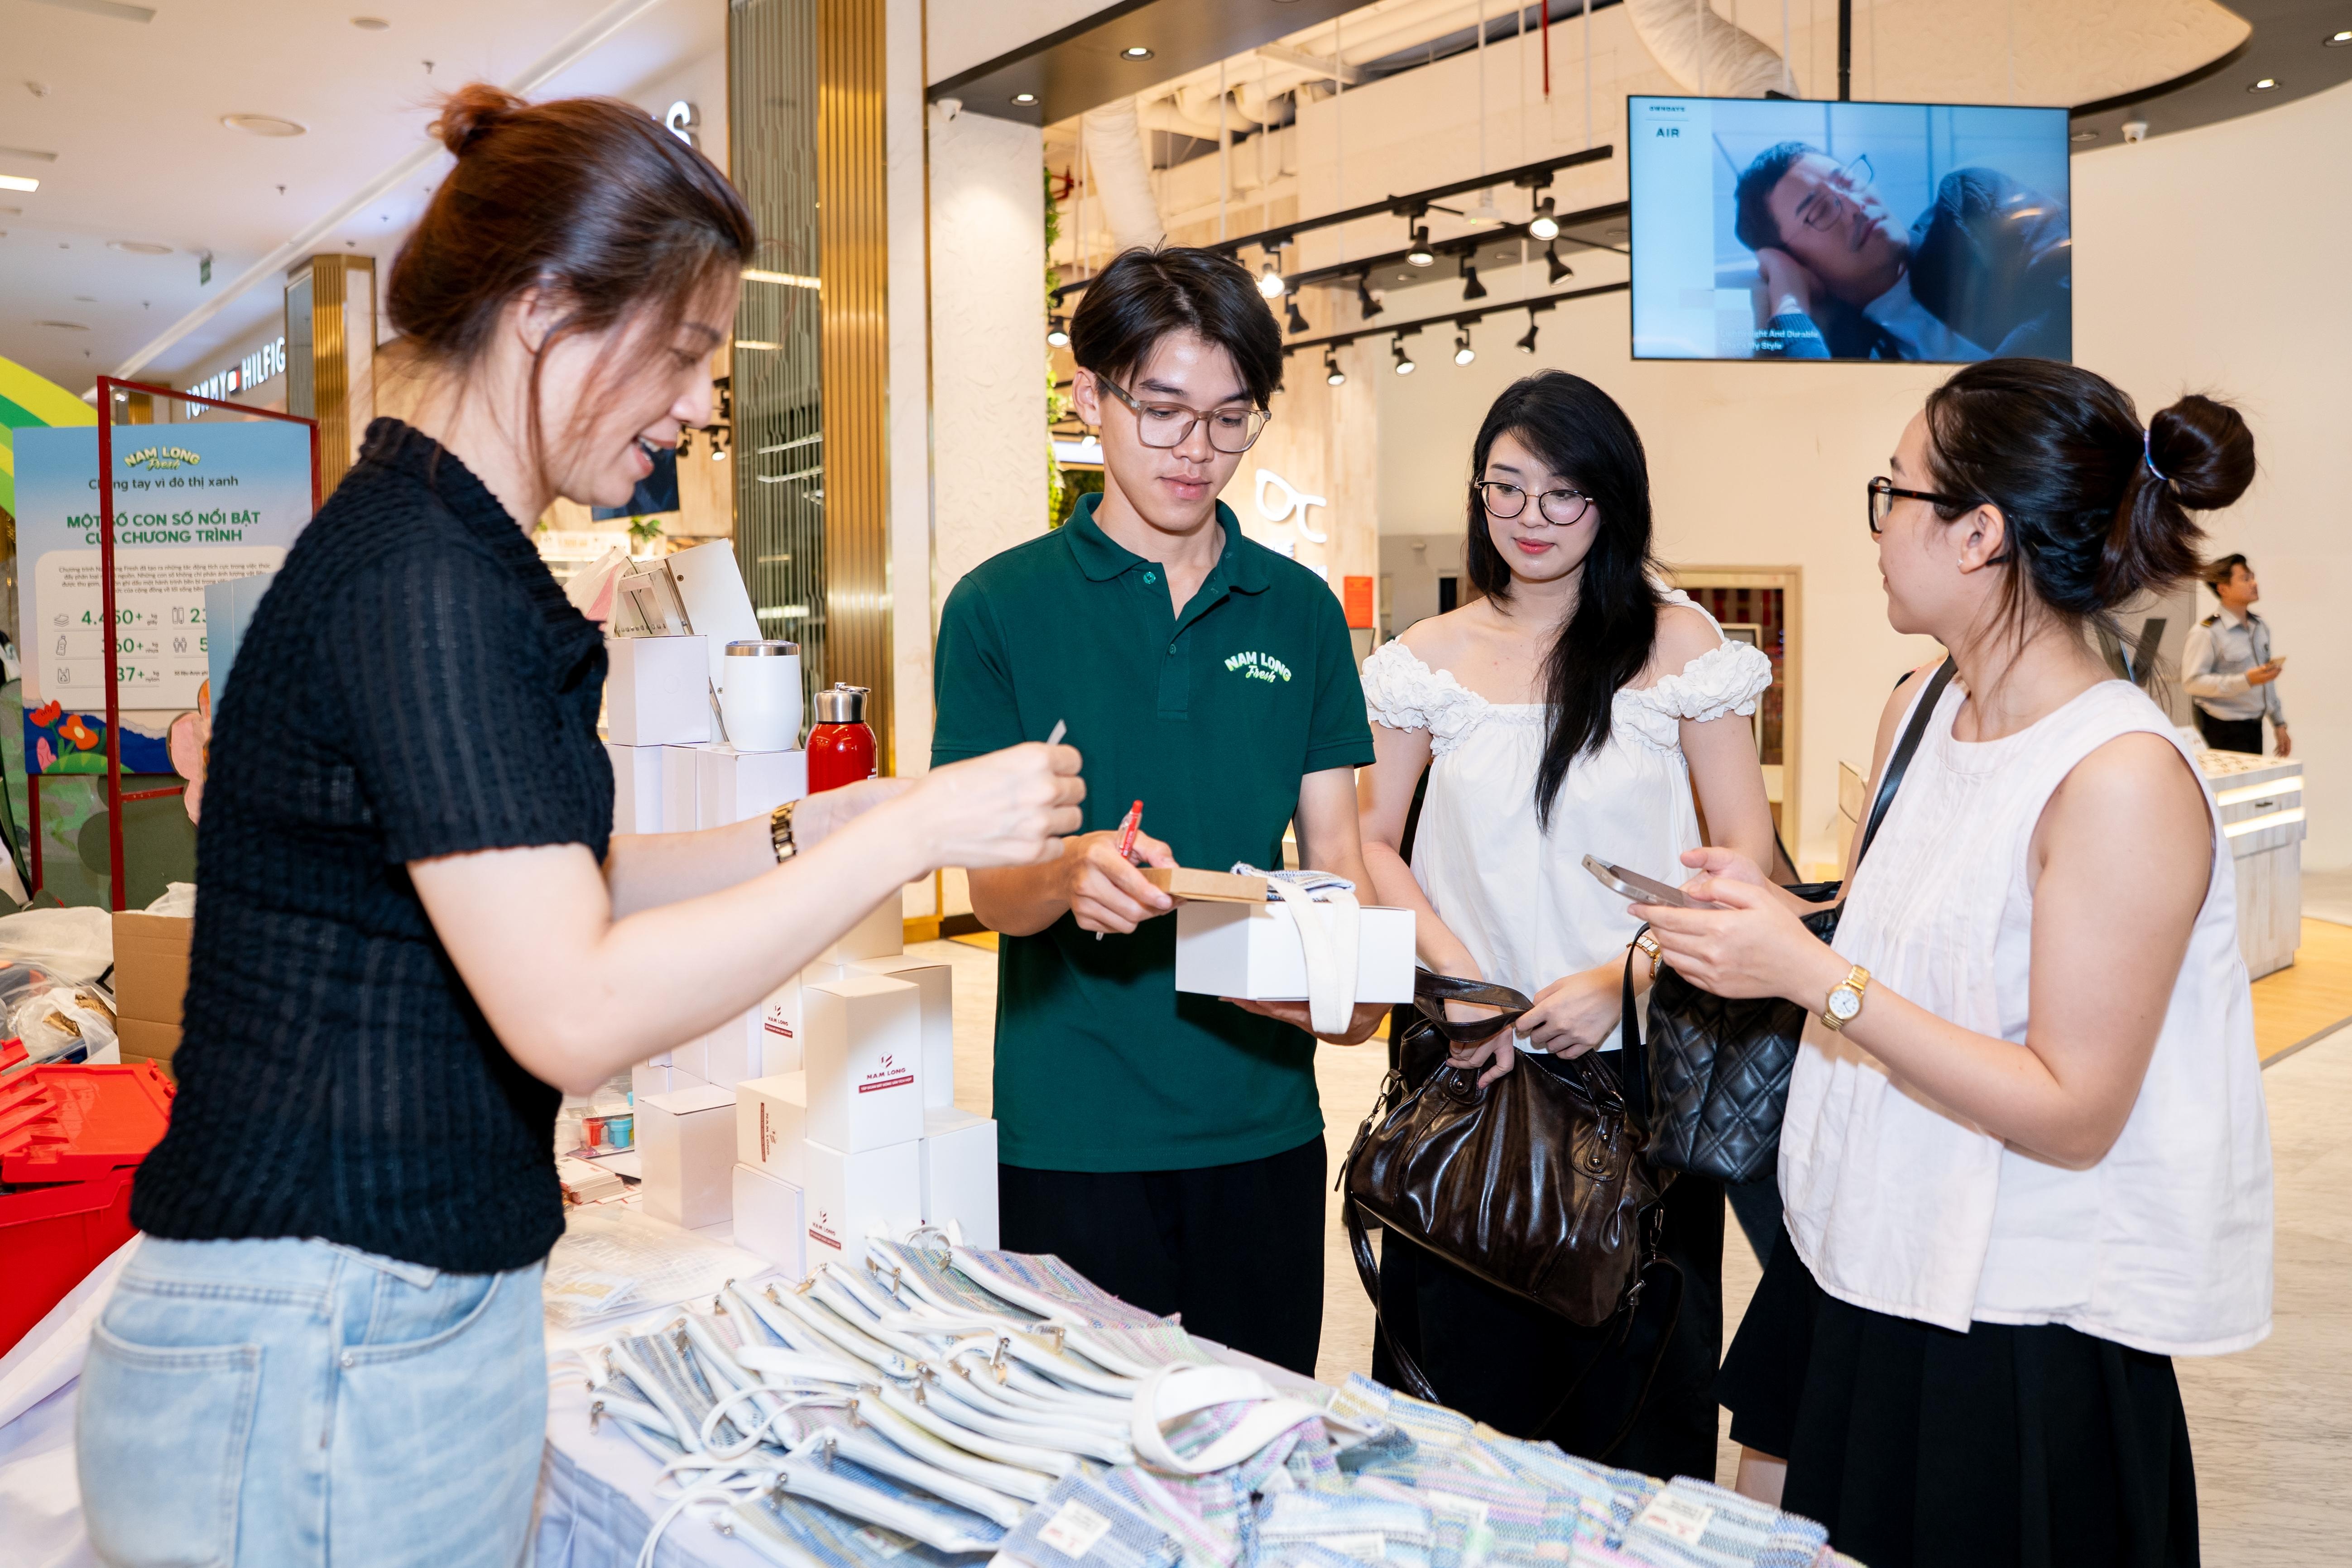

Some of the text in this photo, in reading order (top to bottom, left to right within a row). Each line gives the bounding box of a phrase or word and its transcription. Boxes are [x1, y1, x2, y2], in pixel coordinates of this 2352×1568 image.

[1656, 128, 1680, 138] AIR
[1769, 328, 1785, 337] And
[1786, 329, 1819, 338] Durable
[1761, 341, 1784, 350] Style
[124, 446, 201, 467] NAM LONG
[147, 459, 181, 471] Fresh
[89, 476, 239, 491] Cng tay vì đô thị xanh
[133, 514, 167, 527] CON
[172, 510, 194, 527] SỐ
[198, 508, 226, 526] NỔI
[231, 509, 261, 527] BẬT
[122, 530, 192, 544] CHƯƠNG
[196, 527, 243, 542] TRÌNH
[1224, 651, 1292, 682] NAM LONG
[1245, 665, 1276, 683] Fresh
[887, 1068, 906, 1076] LONG
